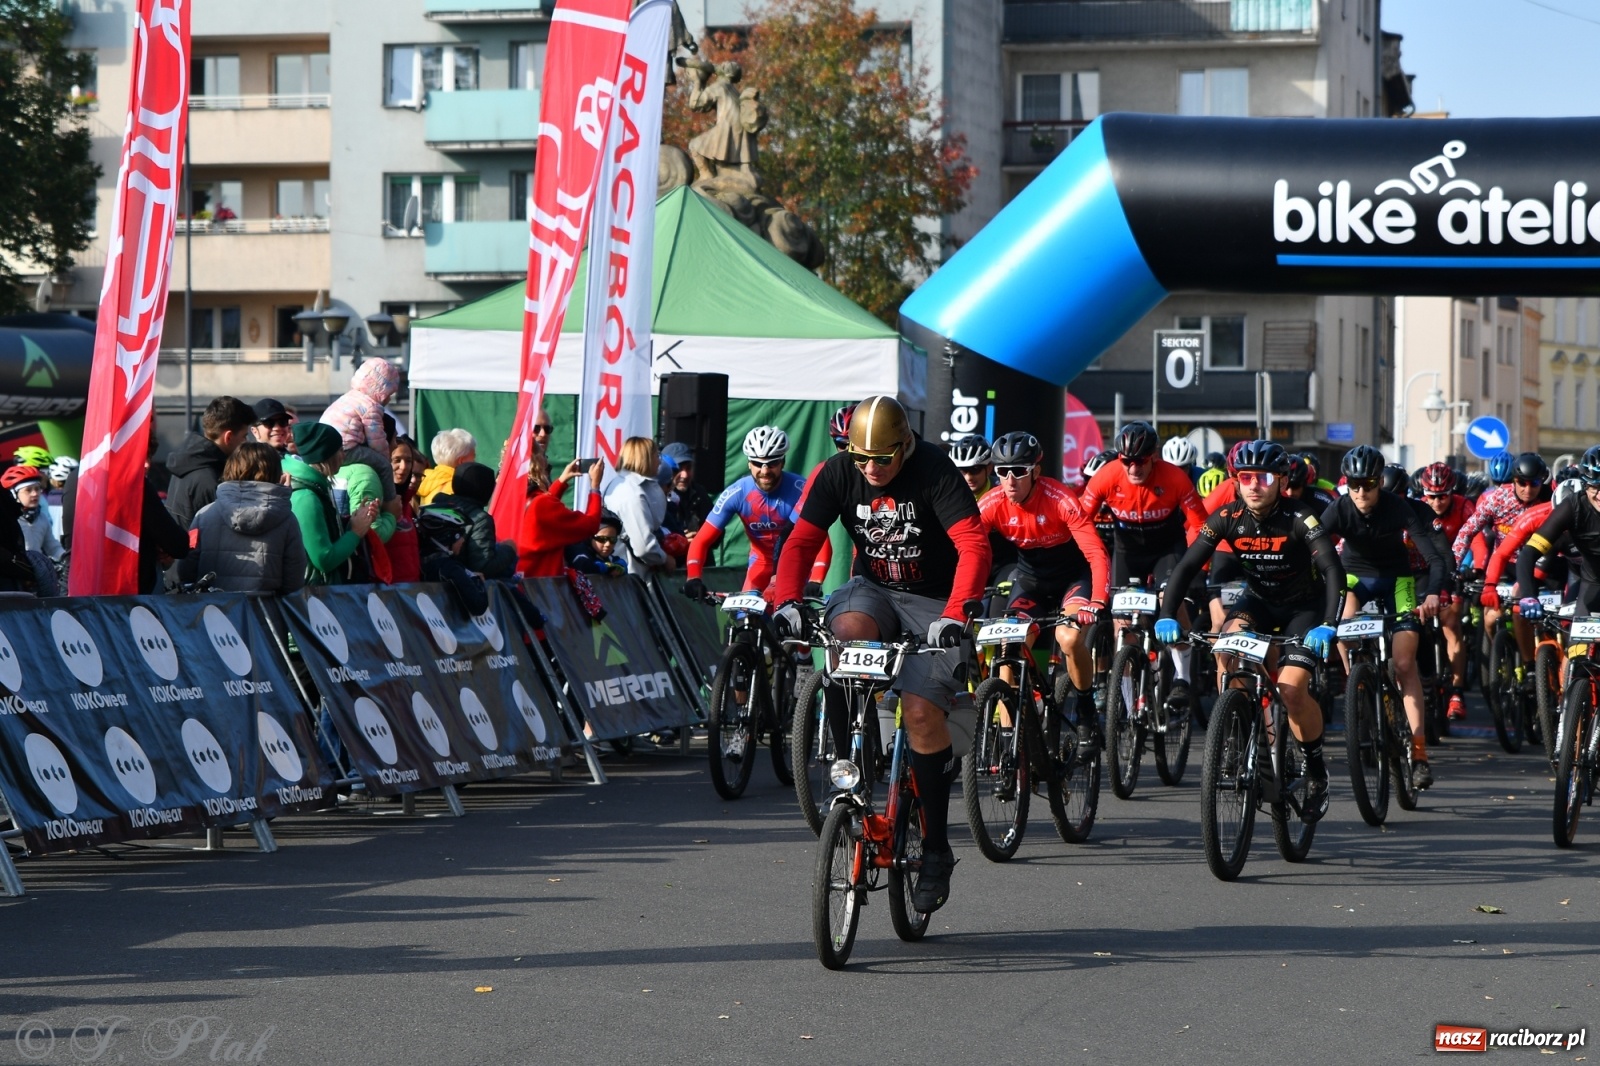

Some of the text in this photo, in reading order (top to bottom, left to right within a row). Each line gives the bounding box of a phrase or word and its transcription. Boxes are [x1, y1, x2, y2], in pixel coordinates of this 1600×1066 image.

[1273, 179, 1416, 244] bike
[595, 52, 648, 468] RACIBÓRZ
[1161, 338, 1200, 347] SEKTOR
[1165, 349, 1194, 388] 0
[940, 388, 979, 446] ier
[1111, 507, 1171, 520] DAR-BUD
[731, 598, 760, 607] 1177
[1120, 596, 1149, 606] 3174
[987, 626, 1020, 636] 1626
[1345, 622, 1375, 633] 2202
[1224, 638, 1259, 651] 1407
[841, 652, 885, 668] 1184
[148, 684, 204, 703] KOKOwear
[584, 671, 675, 709] MERDA
[70, 691, 128, 711] KOKOwear
[276, 784, 323, 805] KOKOwear
[203, 796, 258, 816] KOKOwear
[128, 807, 183, 828] KOKOwear
[44, 818, 104, 841] KOKOwear
